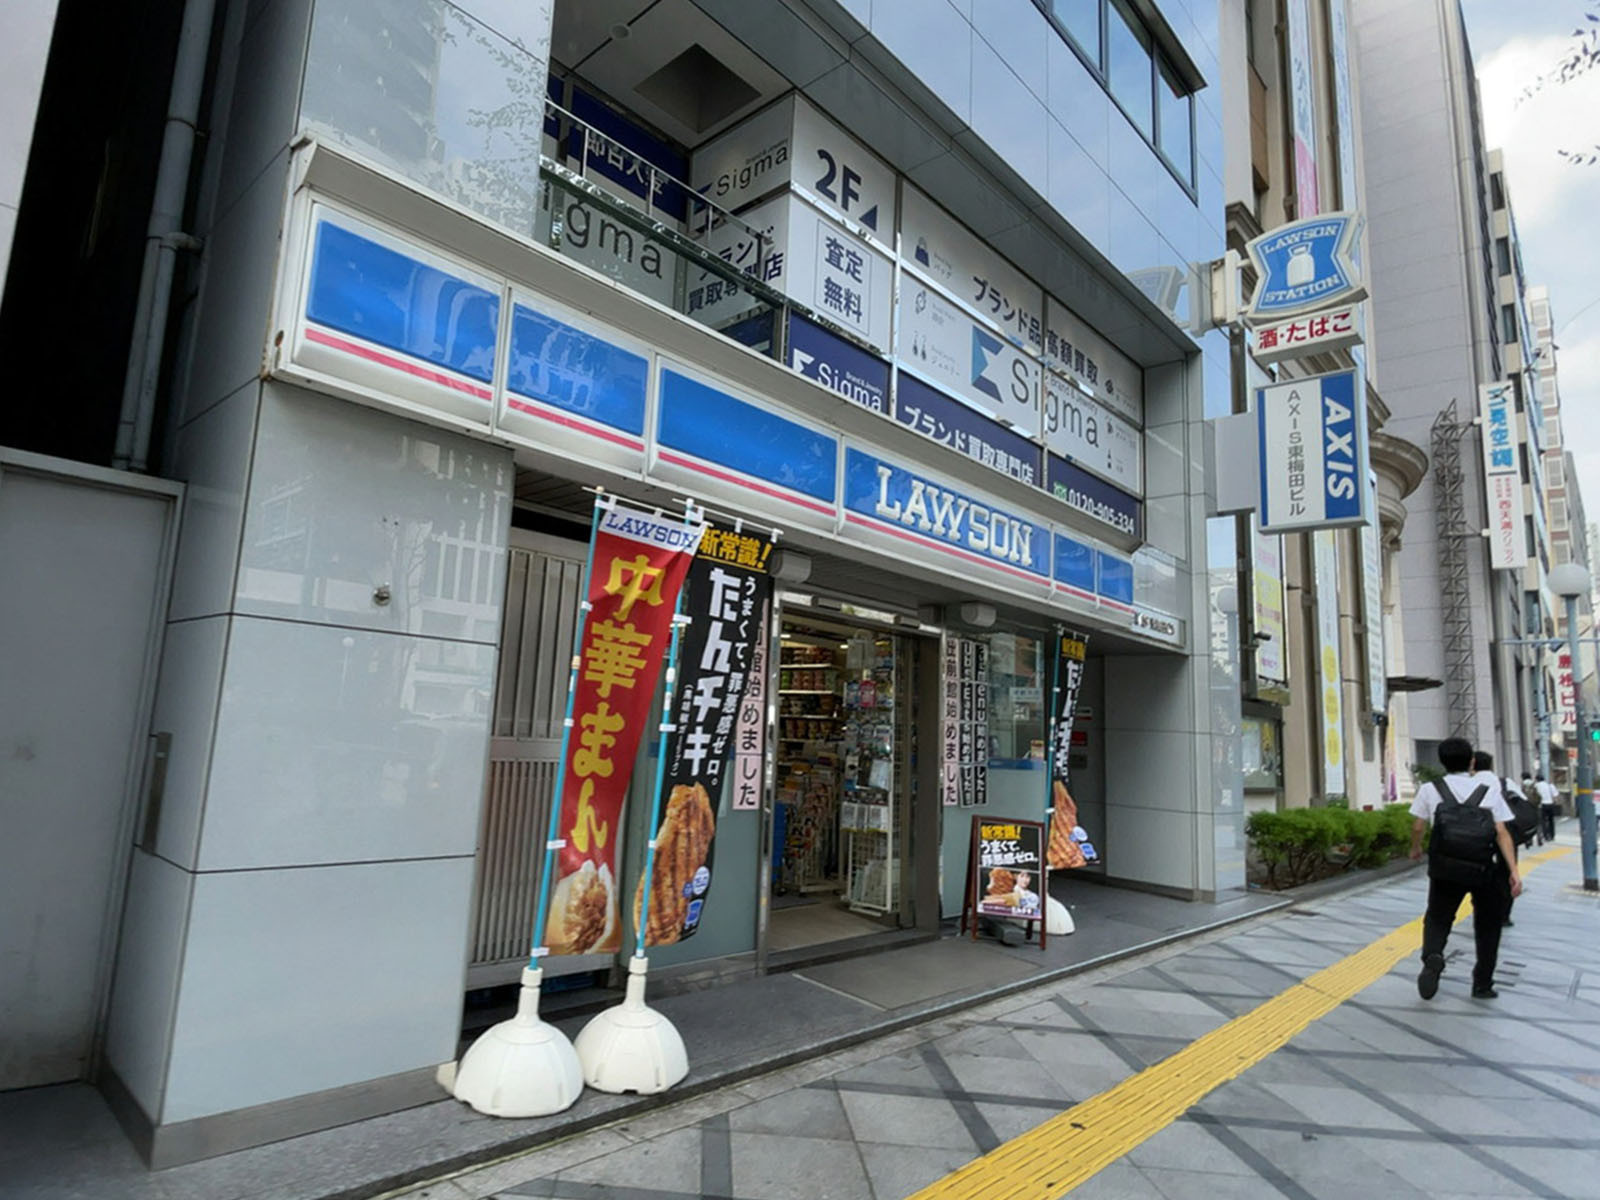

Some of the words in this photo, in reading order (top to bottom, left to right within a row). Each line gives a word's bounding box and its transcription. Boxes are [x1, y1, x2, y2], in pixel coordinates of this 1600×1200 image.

[716, 146, 787, 197] Sigma
[815, 149, 862, 211] 2F
[825, 235, 863, 283] 査定
[1264, 225, 1338, 254] LAWSON
[824, 277, 862, 324] 無料
[1265, 274, 1340, 302] STATION
[817, 362, 882, 412] Sigma
[1011, 358, 1099, 448] Sigma
[904, 405, 1034, 486] ブランド買取専門店
[1325, 396, 1355, 500] AXIS
[606, 513, 698, 549] LAWSON
[876, 466, 1033, 567] LAWSON
[700, 528, 772, 568] 新常識!
[683, 567, 741, 776] たんチキ
[571, 553, 665, 853] 中華まん
